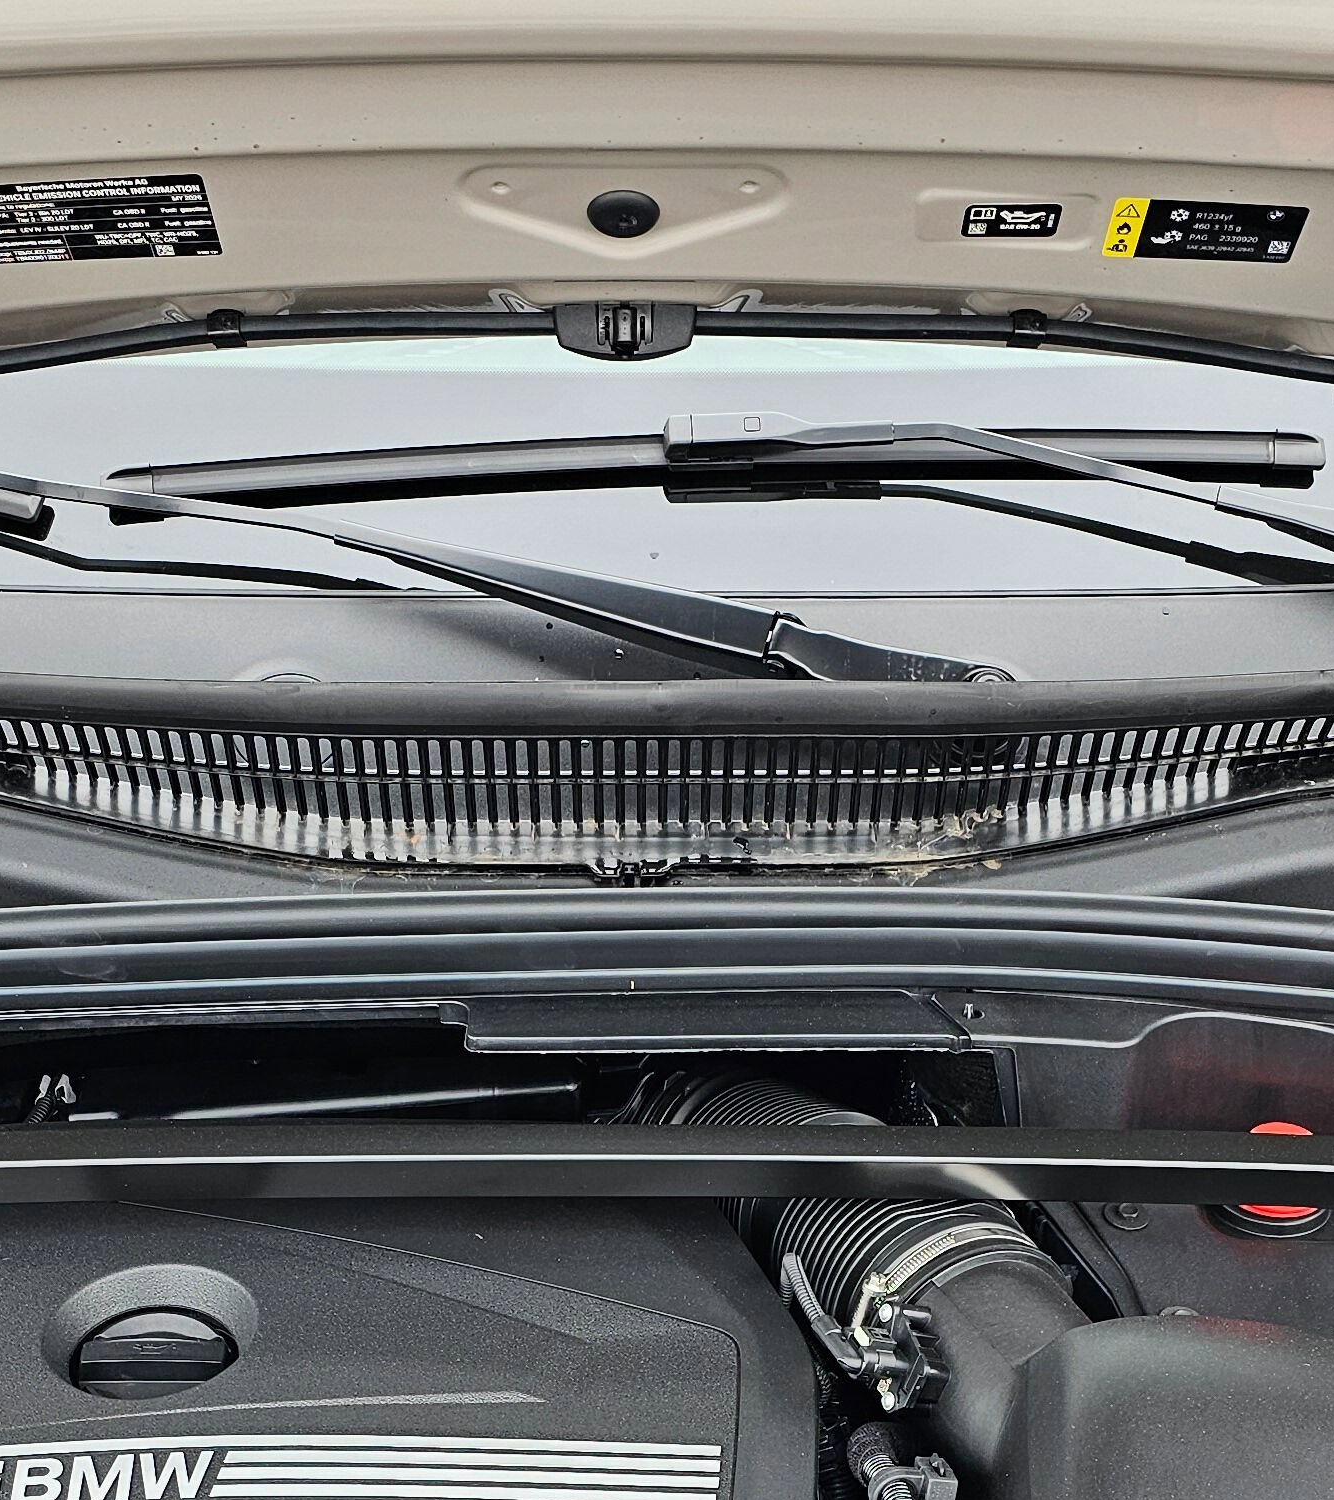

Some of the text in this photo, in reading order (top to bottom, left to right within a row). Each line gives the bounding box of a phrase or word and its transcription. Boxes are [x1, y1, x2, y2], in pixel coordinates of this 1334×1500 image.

[15, 178, 148, 193] Bayerische Motoren Werke AG
[32, 191, 81, 200] EMISSION
[82, 187, 129, 198] CONTROL
[130, 184, 200, 196] INFORMATION
[1195, 212, 1234, 222] R1234yf
